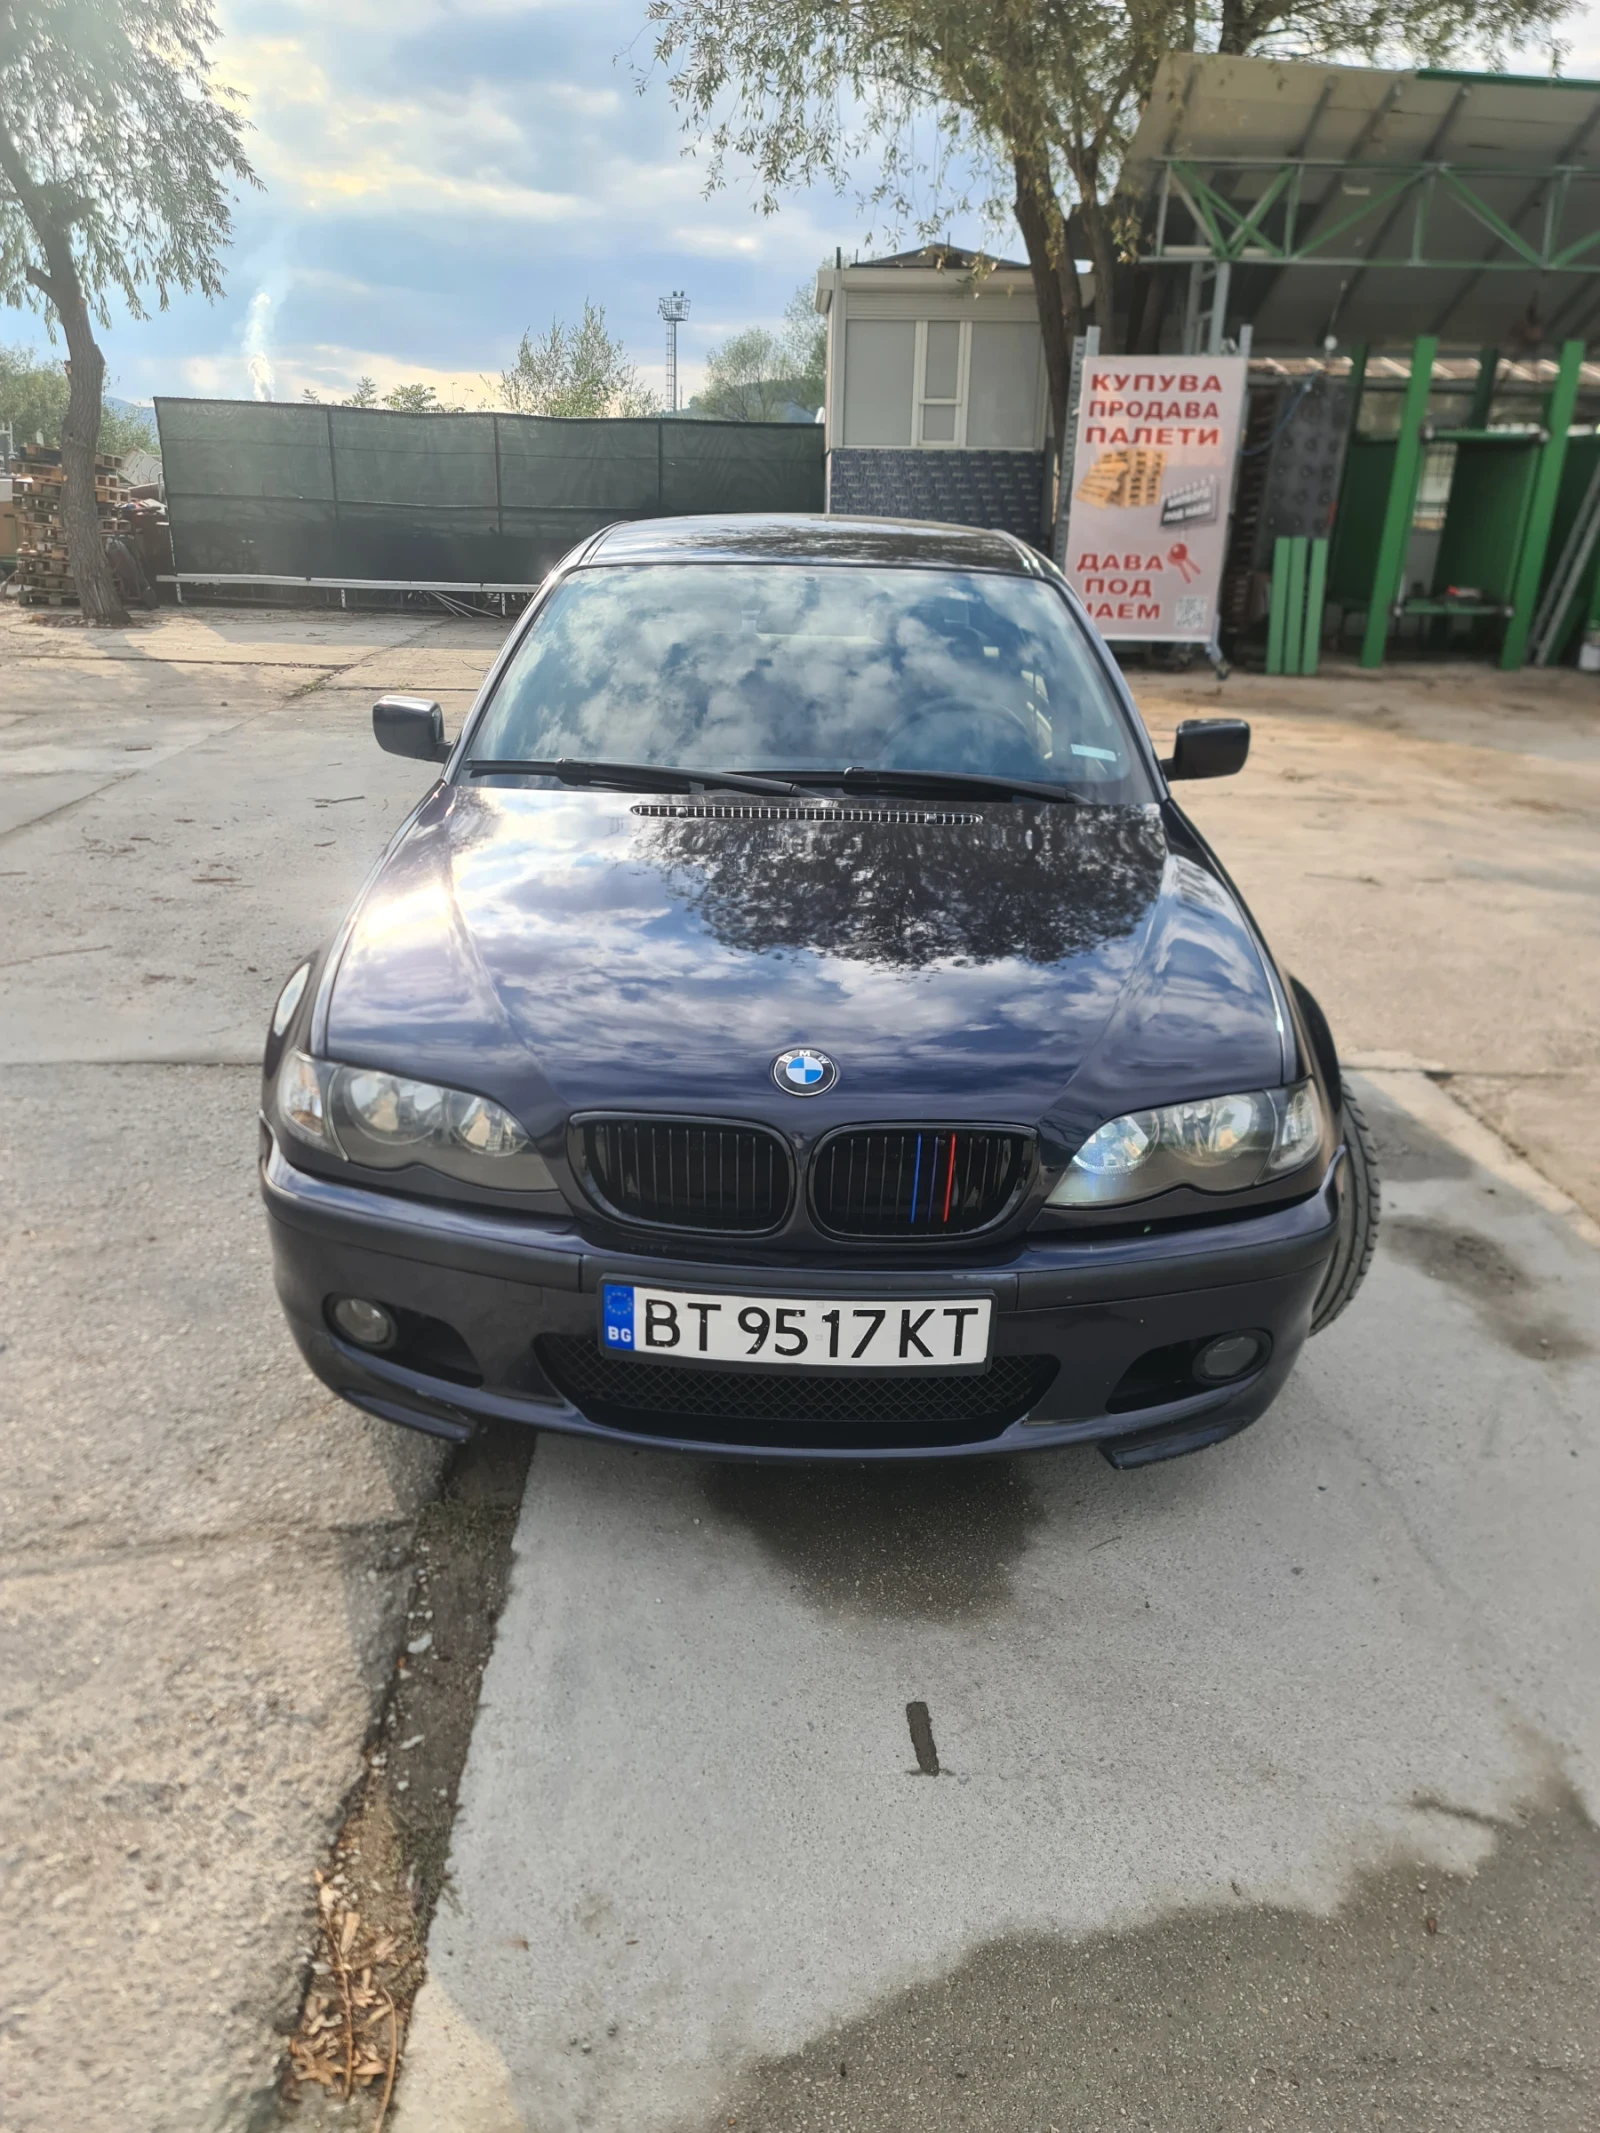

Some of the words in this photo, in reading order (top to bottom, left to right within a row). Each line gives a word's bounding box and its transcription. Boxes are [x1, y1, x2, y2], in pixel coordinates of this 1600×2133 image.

[1090, 374, 1222, 393] КУПУВА
[1088, 401, 1219, 421] ПРОДАВА
[1085, 427, 1219, 445] ПАЛЕТИ
[1077, 553, 1163, 573] ДАВА
[1085, 579, 1152, 598] ПОД
[778, 1050, 830, 1064] BMW
[607, 1326, 632, 1342] BG
[645, 1298, 722, 1351] BT
[737, 1306, 886, 1358] 9517
[898, 1308, 979, 1358] KT
